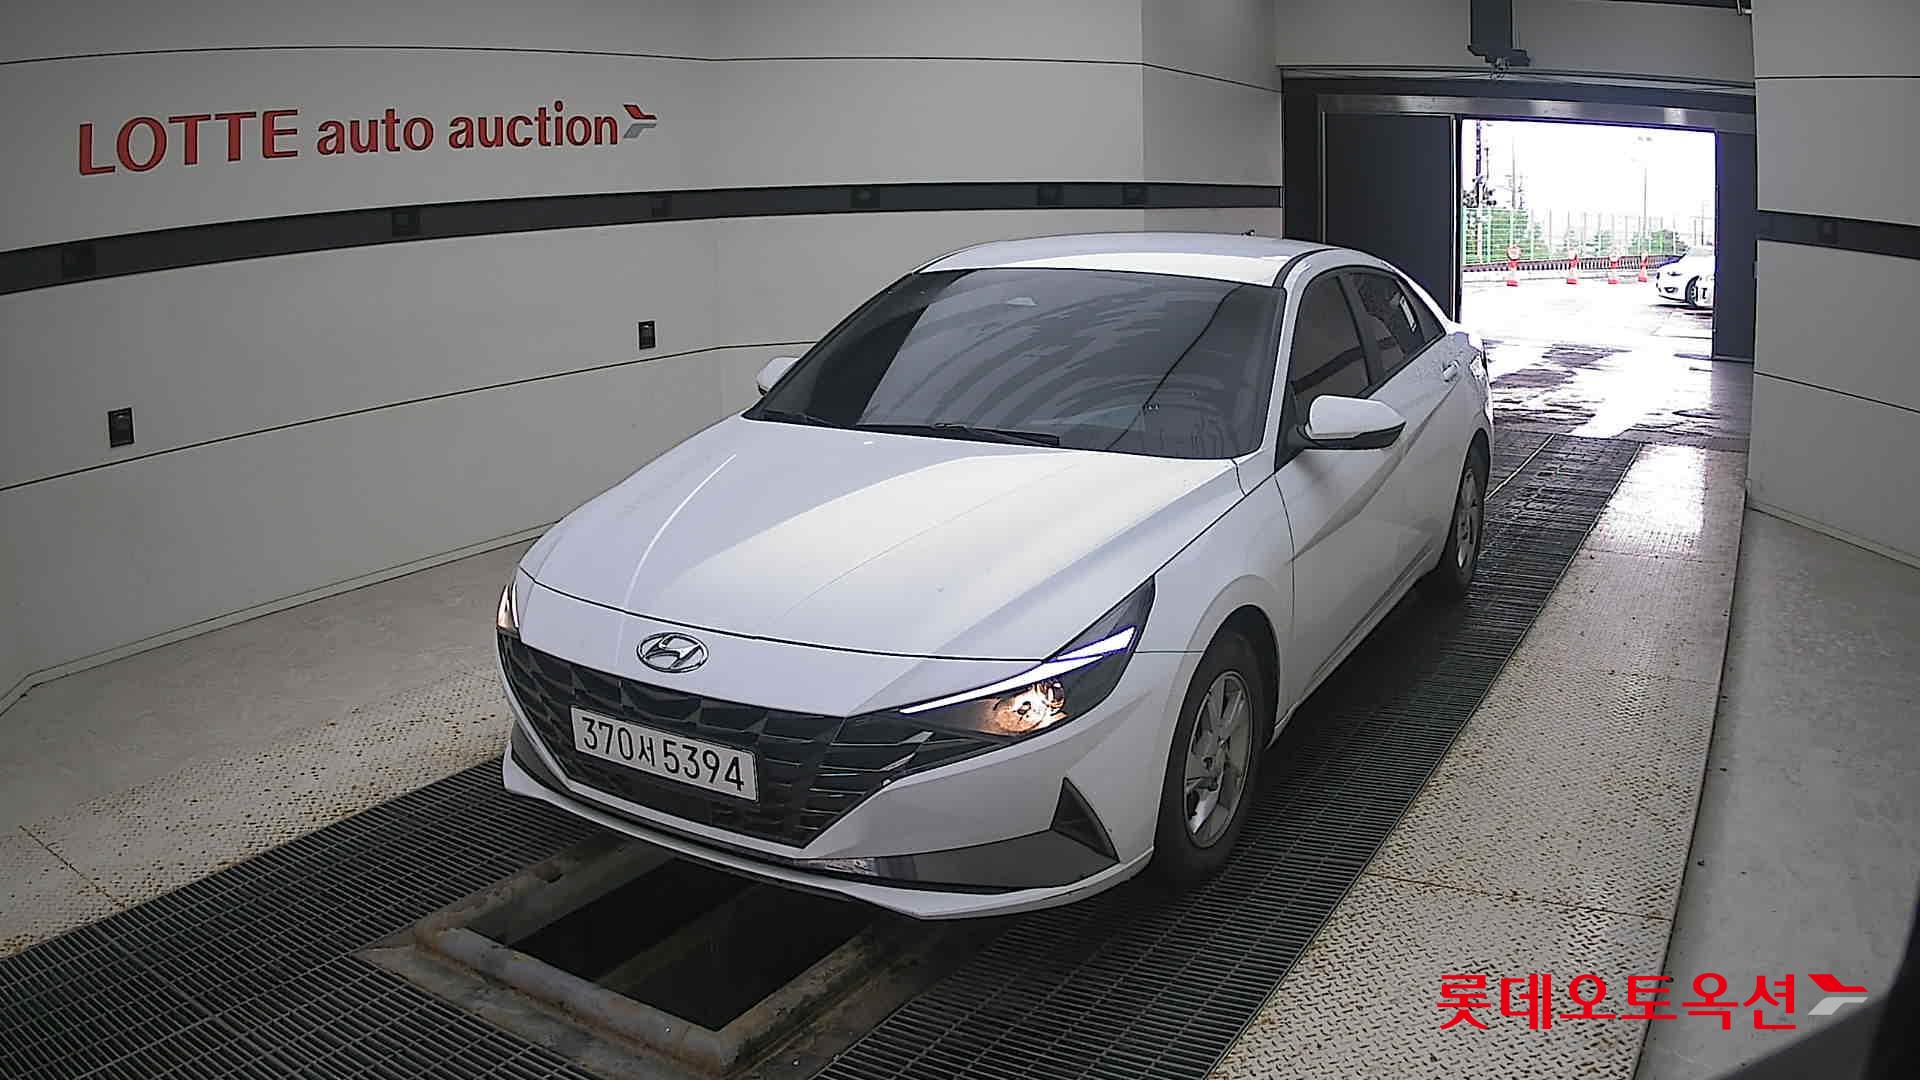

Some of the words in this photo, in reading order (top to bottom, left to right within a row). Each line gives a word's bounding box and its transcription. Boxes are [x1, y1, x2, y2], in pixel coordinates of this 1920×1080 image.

[79, 110, 298, 175] LOTTE
[318, 109, 433, 155] auto
[450, 101, 619, 149] auction
[581, 716, 656, 767] 370서
[663, 738, 745, 792] 5394
